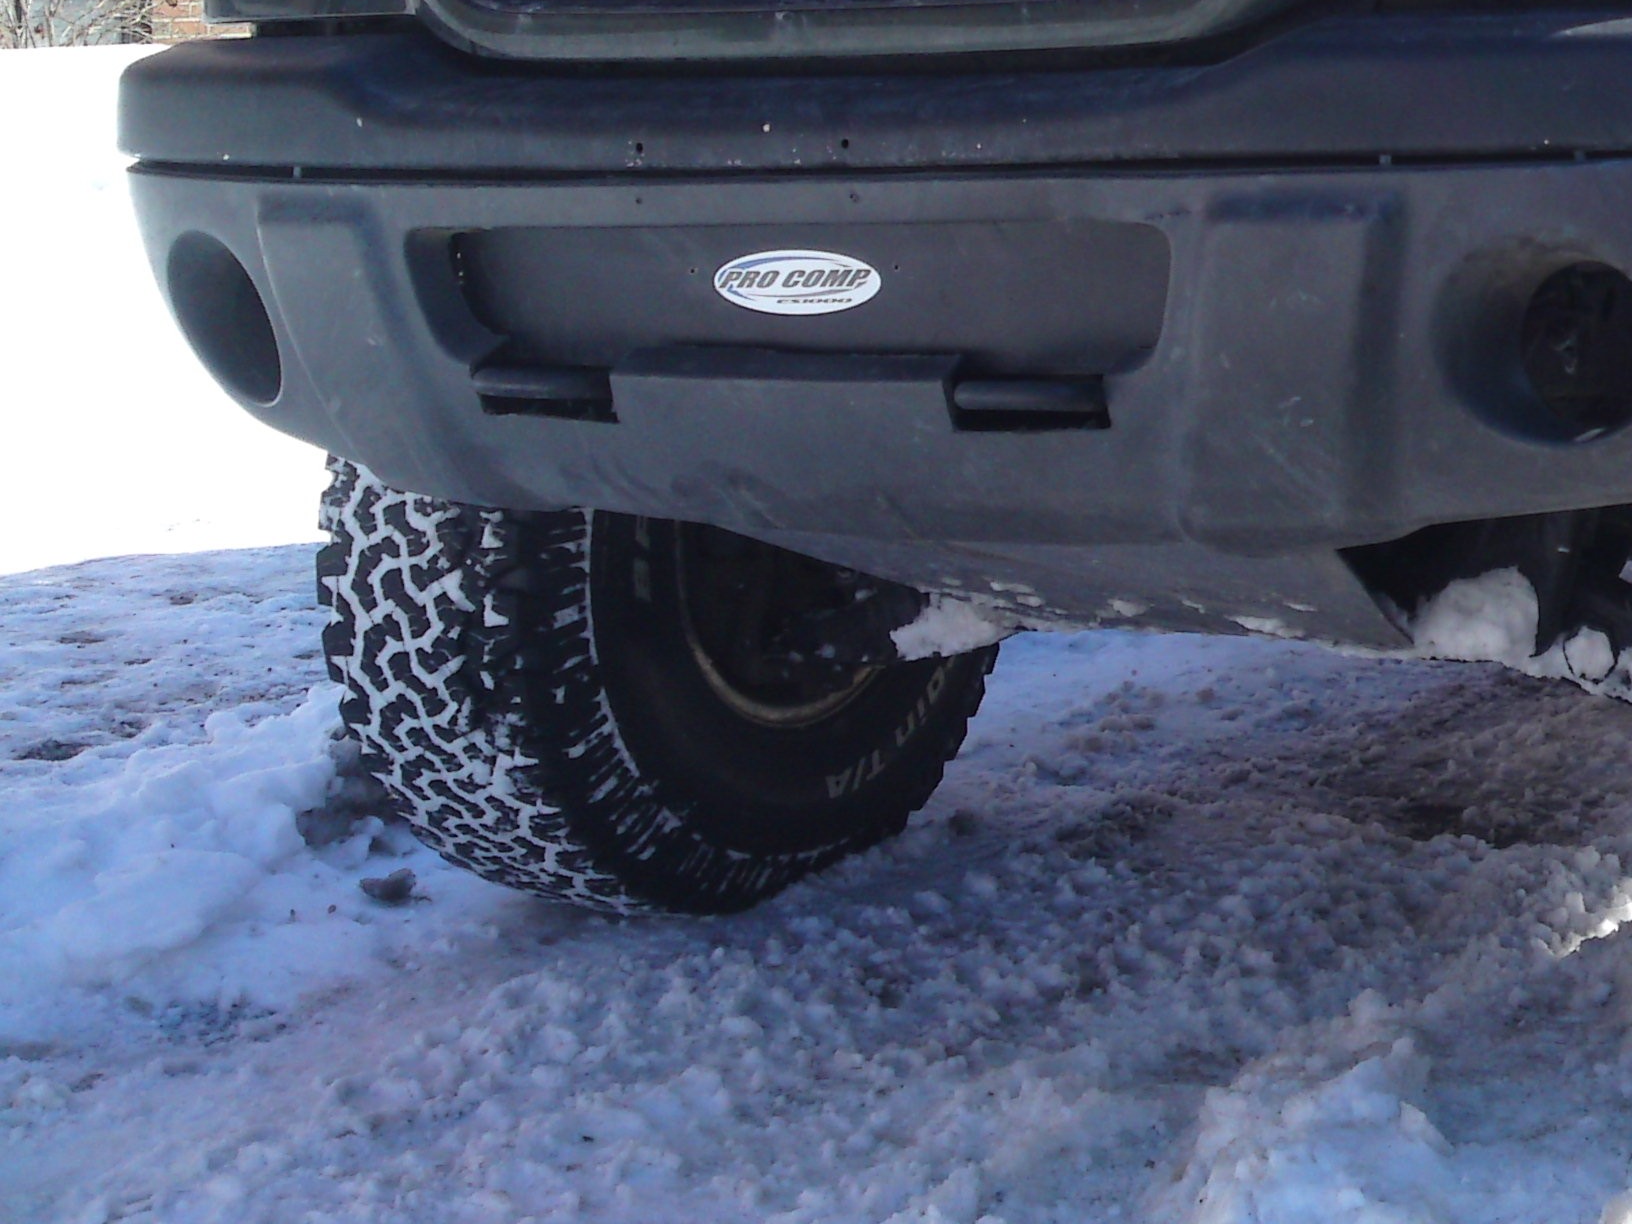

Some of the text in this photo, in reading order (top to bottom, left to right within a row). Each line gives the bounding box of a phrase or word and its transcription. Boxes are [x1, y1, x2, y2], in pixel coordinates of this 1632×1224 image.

[717, 269, 872, 291] PRO COMP
[825, 749, 887, 799] T/A
